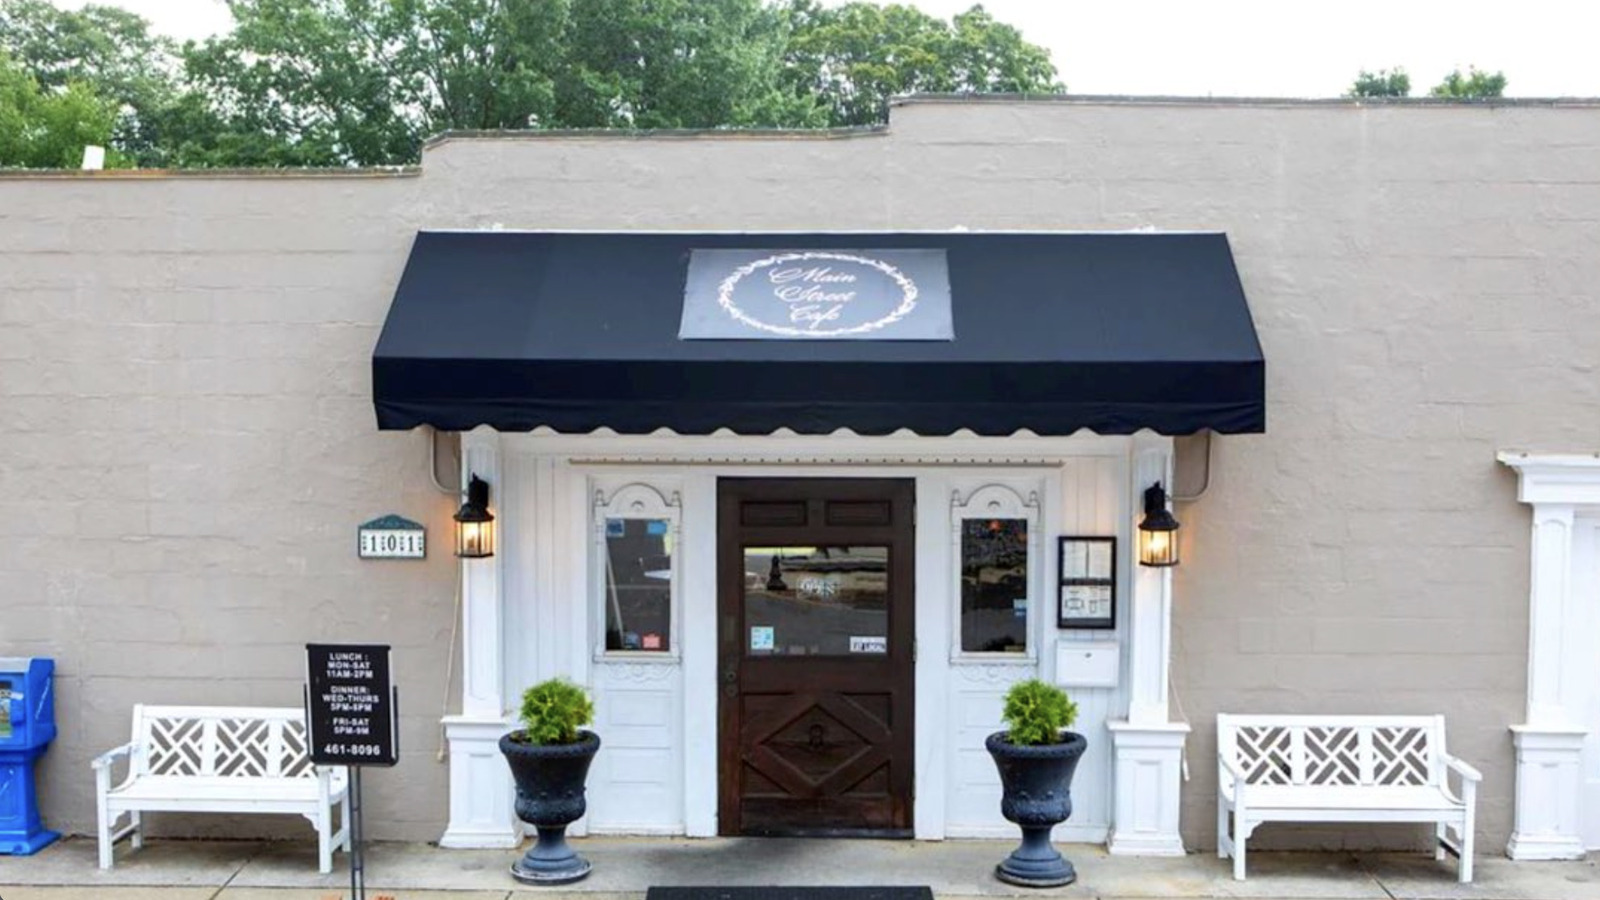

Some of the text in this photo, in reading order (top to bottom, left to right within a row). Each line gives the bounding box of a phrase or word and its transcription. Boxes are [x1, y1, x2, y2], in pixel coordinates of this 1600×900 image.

[768, 267, 857, 283] Main
[774, 284, 857, 302] Street
[327, 661, 371, 670] MON-SAT
[326, 670, 374, 678] 11AM-2PM
[322, 694, 380, 703] WED-THURS
[333, 717, 370, 726] FRI-SAT
[324, 744, 380, 756] 461-8096
